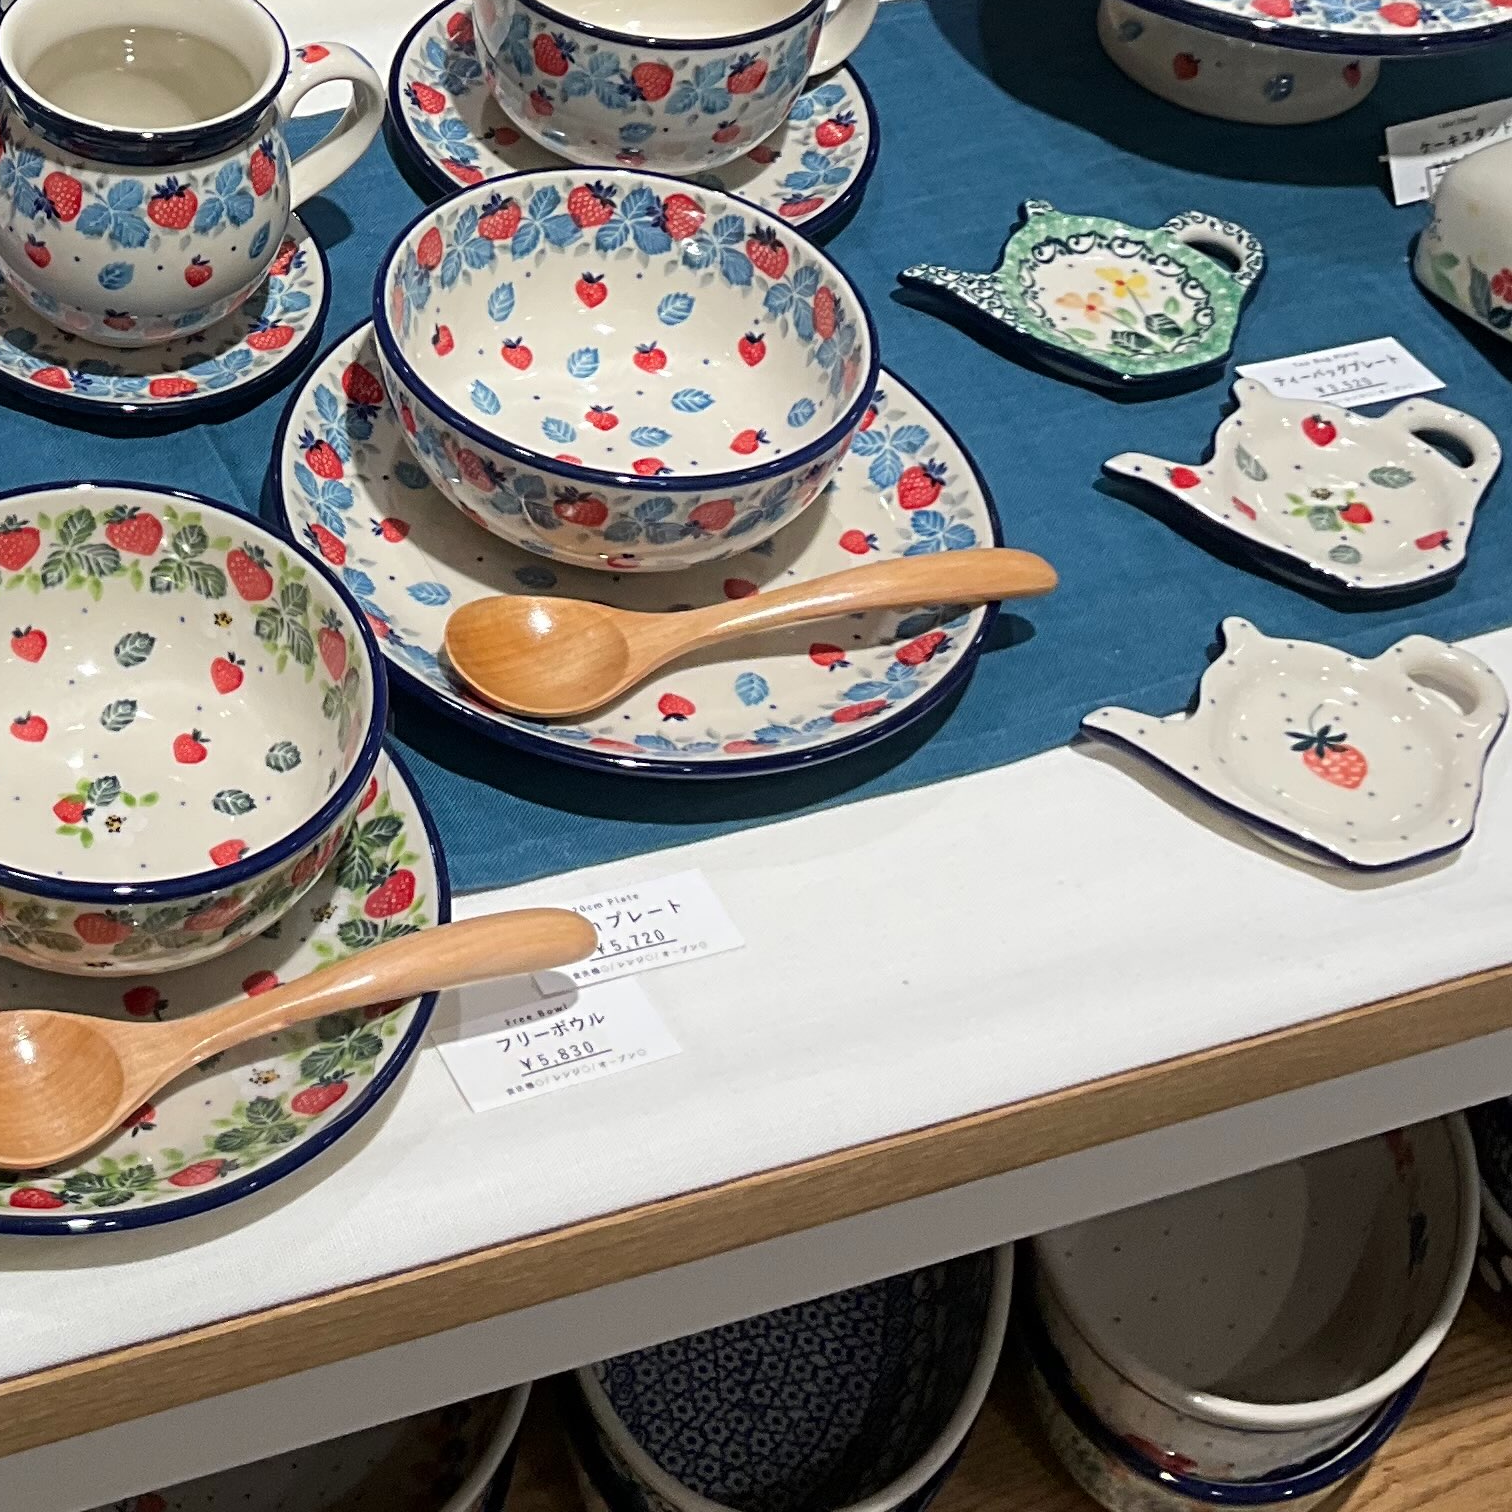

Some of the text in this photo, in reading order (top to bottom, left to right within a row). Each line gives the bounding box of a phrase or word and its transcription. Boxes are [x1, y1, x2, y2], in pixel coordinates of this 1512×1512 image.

[607, 891, 639, 906] Plate
[596, 929, 665, 955] ¥5,720
[504, 1002, 568, 1026] Free Bowl
[496, 1012, 606, 1053] フリーボウル
[519, 1041, 594, 1071] ¥5,830
